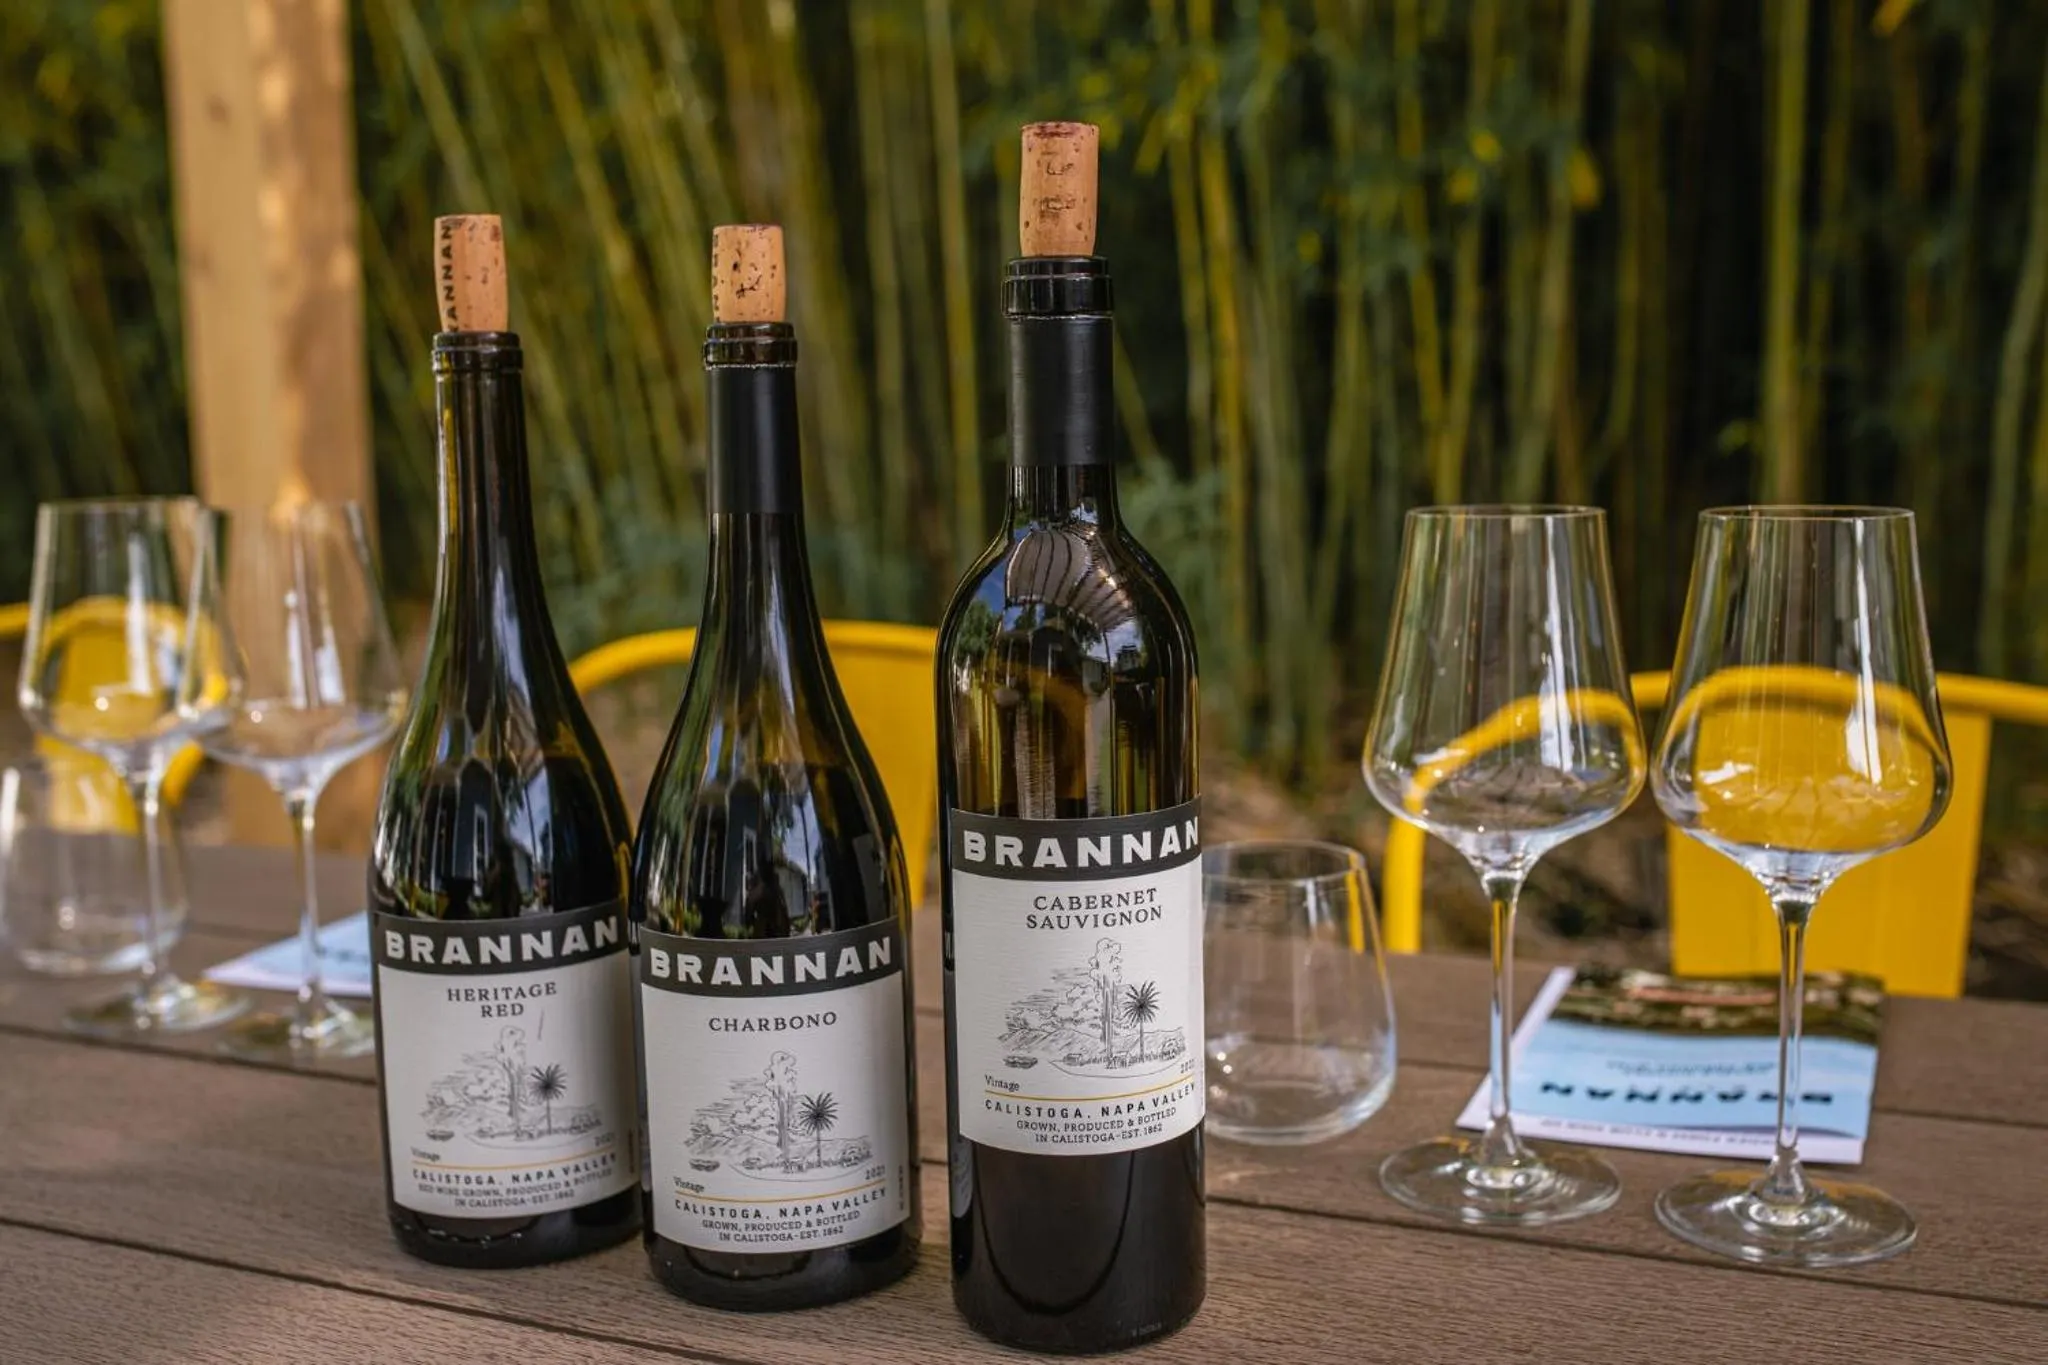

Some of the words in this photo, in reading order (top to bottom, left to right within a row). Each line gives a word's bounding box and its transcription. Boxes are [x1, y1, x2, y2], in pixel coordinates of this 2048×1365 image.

[963, 817, 1198, 867] BRANNAN
[1033, 888, 1157, 911] CABERNET
[1026, 906, 1162, 930] SAUVIGNON
[385, 916, 618, 964] BRANNAN
[650, 936, 891, 986] BRANNAN
[447, 981, 557, 1002] HERITAGE
[481, 1003, 525, 1018] RED
[708, 1011, 837, 1032] CHARBONO
[984, 1074, 1020, 1092] Vintage
[1101, 1101, 1145, 1117] NAPA
[1152, 1082, 1195, 1108] VALLEY
[1017, 1120, 1060, 1133] GROWN,
[1064, 1120, 1124, 1133] PRODUCED
[1127, 1118, 1134, 1127] &
[1137, 1107, 1176, 1125] BOTTLED
[1035, 1133, 1047, 1143] IN
[511, 1169, 555, 1184] NAPA
[562, 1152, 616, 1176] VALLEY
[505, 1181, 562, 1197] PRODUCED
[673, 1176, 705, 1193] Vintage
[779, 1204, 825, 1217] NAPA
[832, 1188, 886, 1211] VALLEY
[702, 1220, 742, 1232] GROWN,
[745, 1221, 802, 1232] PRODUCED
[805, 1219, 813, 1228] &
[816, 1210, 860, 1226] BOTTLED
[719, 1232, 730, 1241] IN
